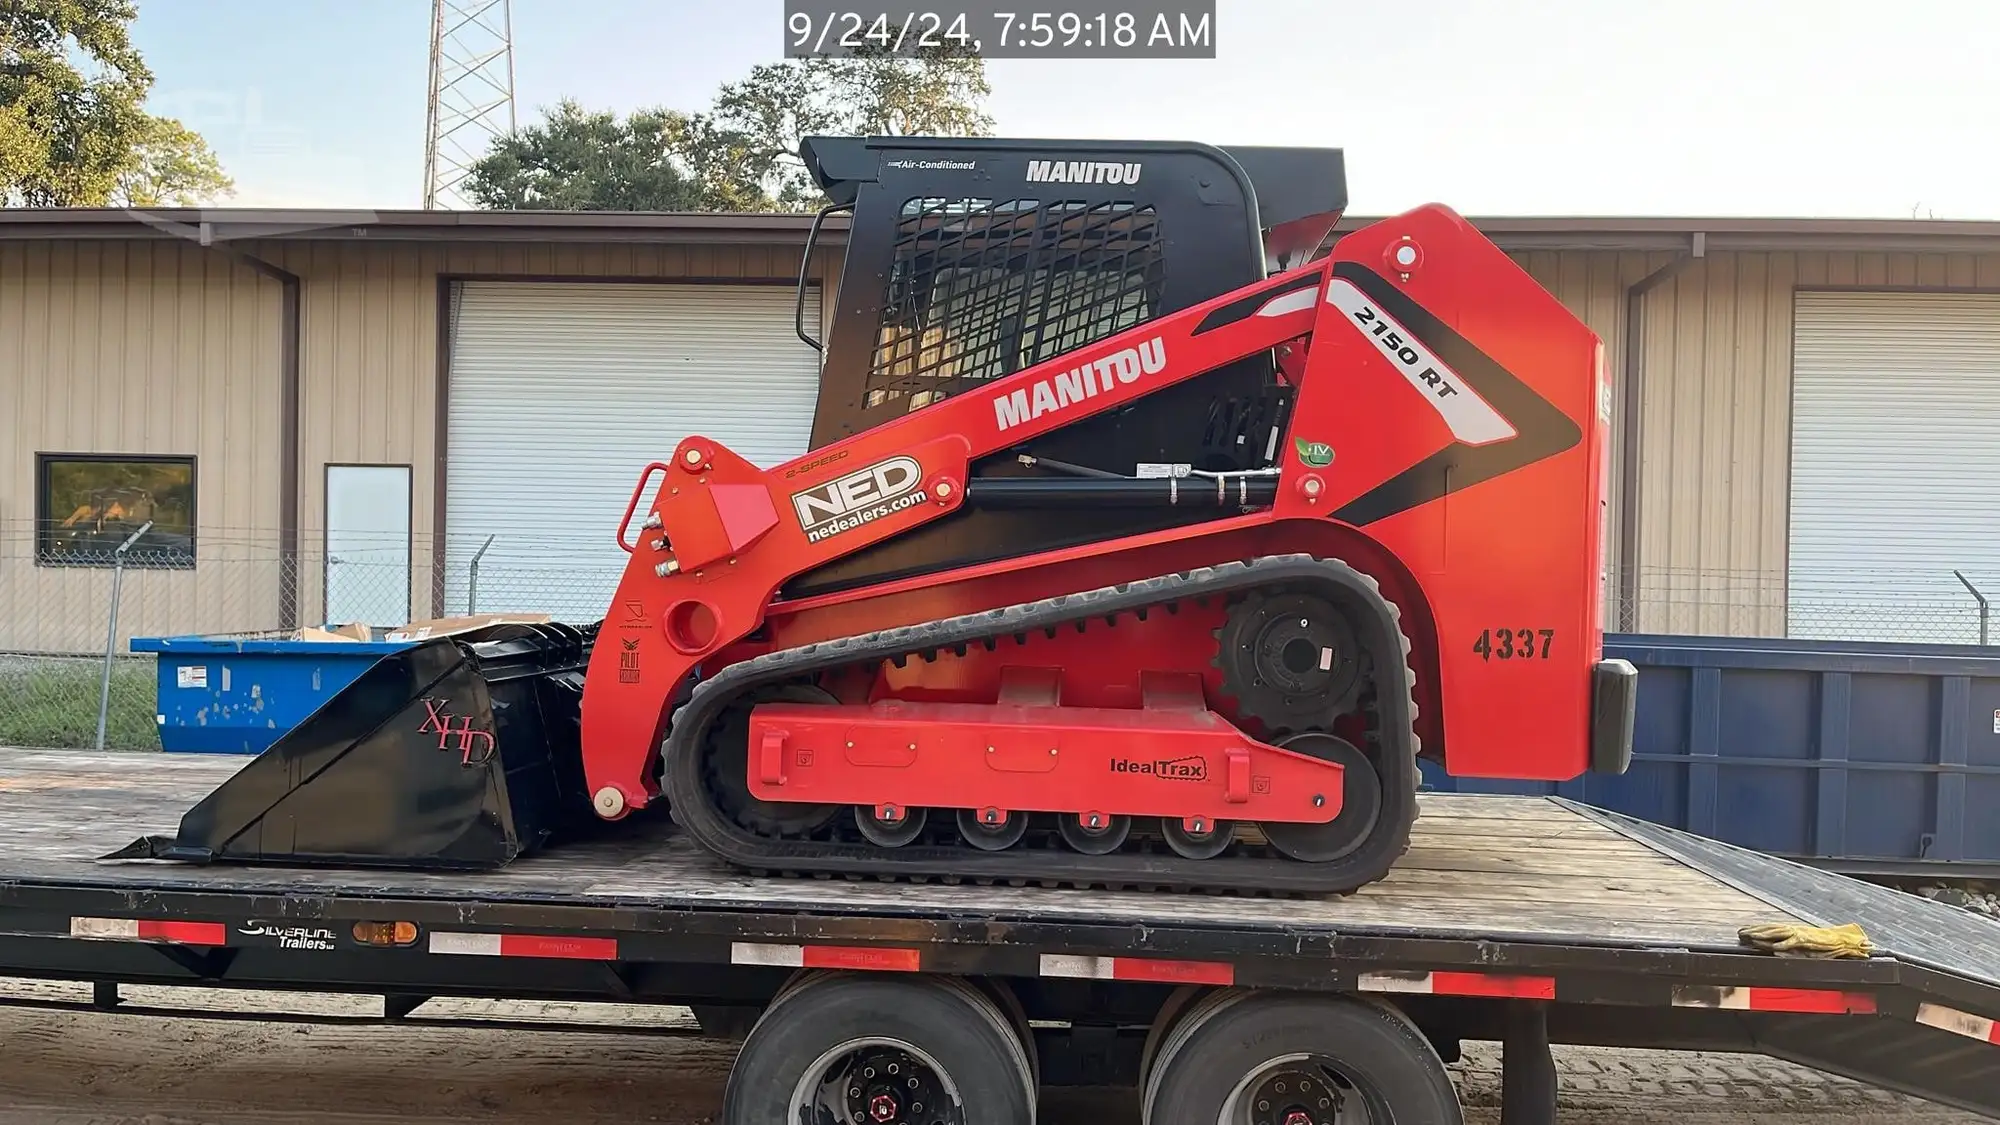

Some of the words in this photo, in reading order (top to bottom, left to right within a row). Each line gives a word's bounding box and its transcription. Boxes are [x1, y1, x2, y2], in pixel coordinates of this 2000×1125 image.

[901, 159, 976, 170] Air-Conditioned
[1026, 160, 1142, 184] MANITOU
[1353, 306, 1419, 365] 2150
[1418, 366, 1458, 397] RT
[993, 336, 1167, 431] MANITOU
[785, 450, 849, 478] 2-SPEED
[795, 458, 919, 526] NED
[807, 491, 927, 542] nedealers.com
[620, 652, 640, 669] PILOT
[1473, 628, 1554, 663] 4337
[416, 696, 497, 767] XHD
[1110, 758, 1202, 777] IdealTrax
[279, 936, 327, 950] Trailers
